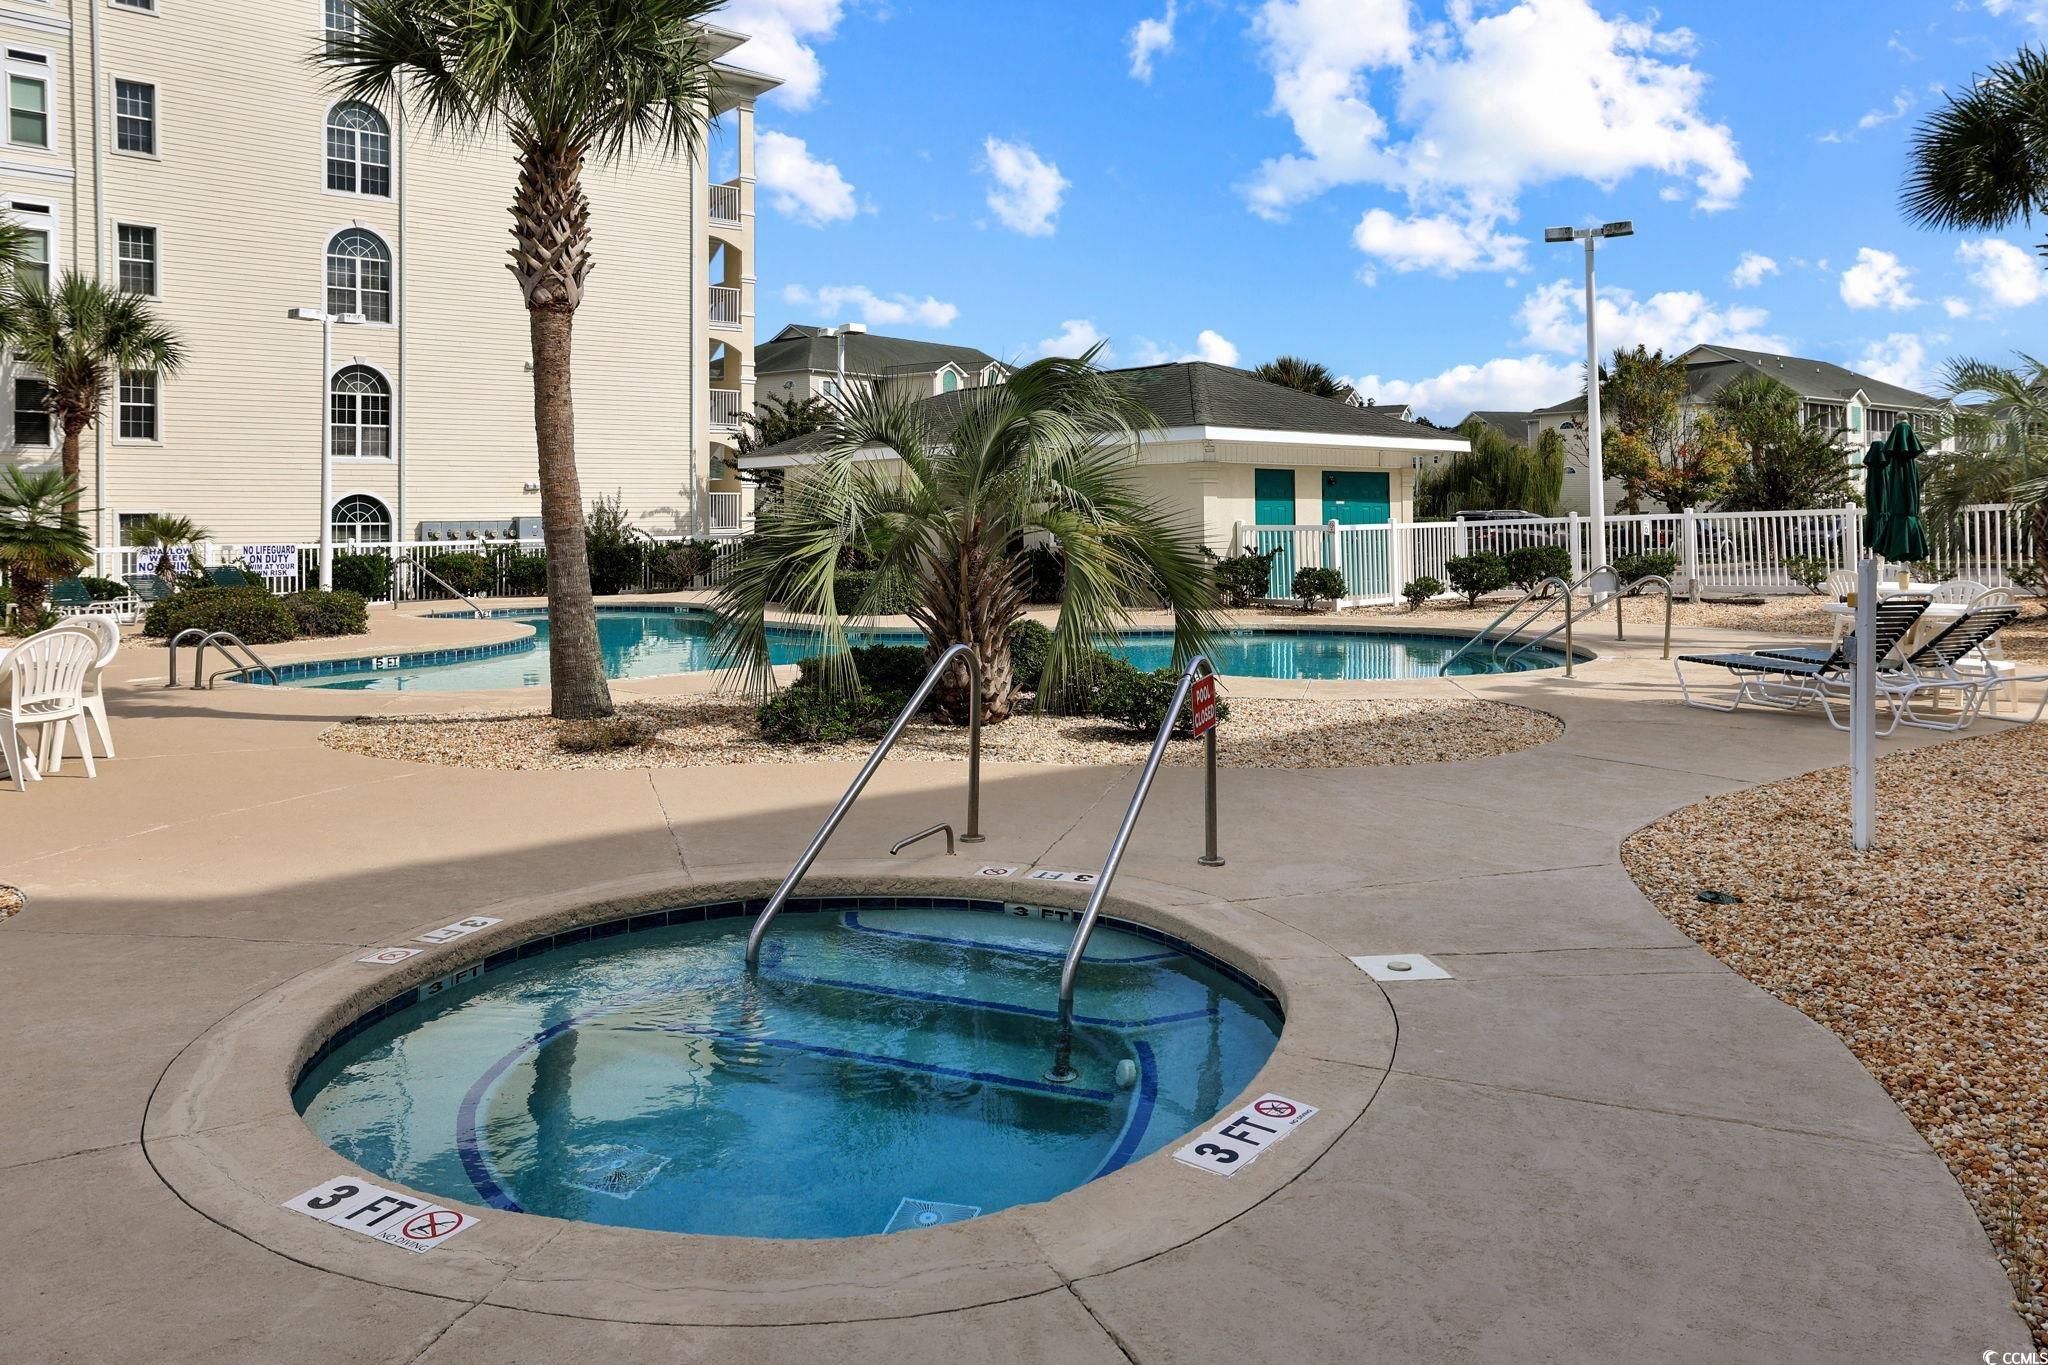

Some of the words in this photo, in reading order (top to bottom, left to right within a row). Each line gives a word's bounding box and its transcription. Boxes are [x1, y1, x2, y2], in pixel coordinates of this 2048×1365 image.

[243, 546, 254, 554] NO
[256, 545, 296, 555] LIFEGUARD
[250, 555, 262, 563] ON
[265, 554, 289, 563] DUTY
[138, 562, 154, 571] NO
[1196, 684, 1211, 705] POOL
[1195, 704, 1215, 728] CLOSED
[1033, 871, 1063, 880] FT
[1074, 874, 1094, 882] 3
[1013, 906, 1029, 917] 3
[1041, 908, 1069, 921] FT
[459, 919, 489, 928] 3
[423, 928, 465, 942] FT
[428, 981, 443, 995] 3
[455, 964, 482, 985] FT
[1194, 1143, 1240, 1164] 3
[1218, 1115, 1278, 1147] FT
[307, 1185, 360, 1210] 3
[344, 1195, 418, 1227] FT
[380, 1231, 397, 1241] NO
[394, 1236, 430, 1251] DIVING
